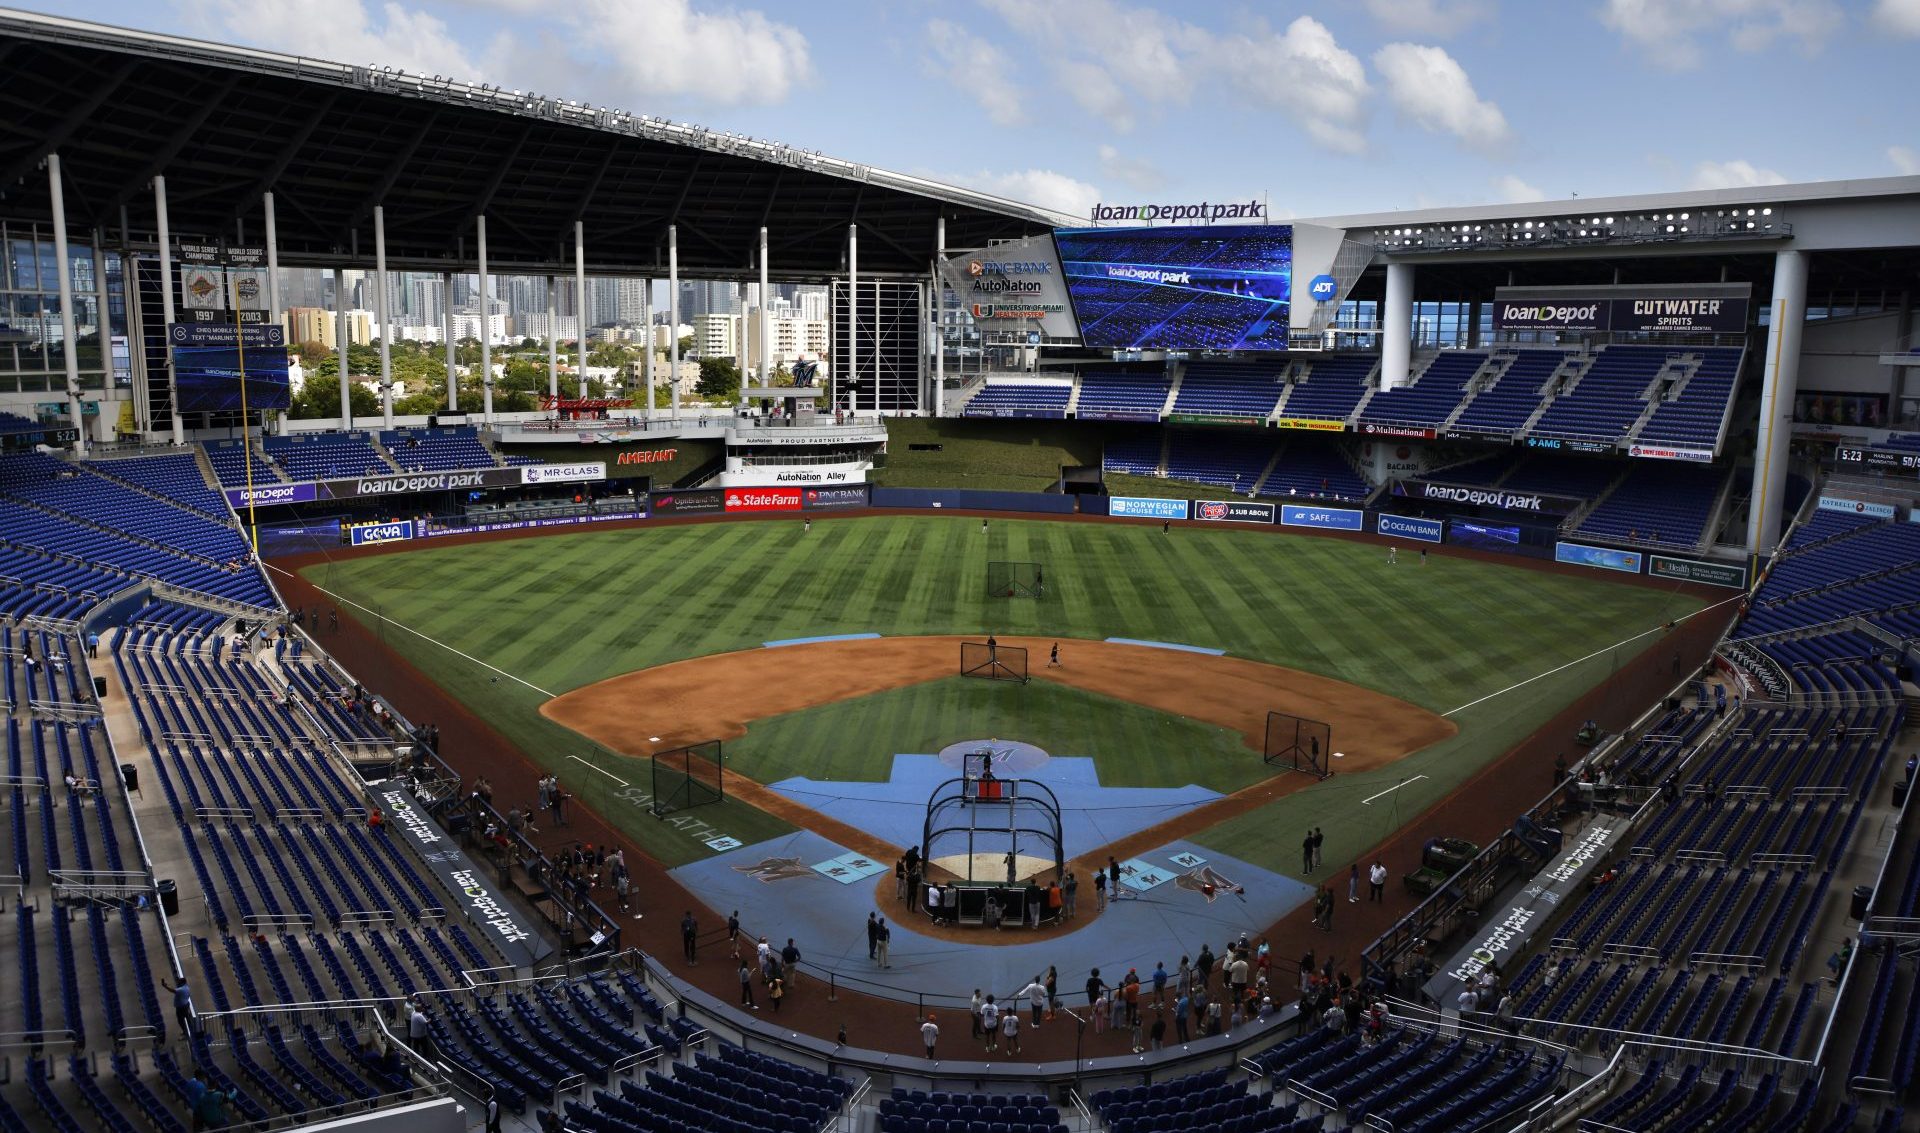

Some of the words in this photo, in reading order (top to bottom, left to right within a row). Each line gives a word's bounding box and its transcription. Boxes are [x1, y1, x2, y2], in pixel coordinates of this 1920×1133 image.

[1095, 202, 1207, 223] loanDepot
[1212, 200, 1262, 222] park
[201, 246, 218, 254] SERIES
[246, 248, 263, 256] SERIES
[185, 252, 215, 261] CHAMPIONS
[231, 254, 260, 262] CHAMPIONS
[984, 262, 1012, 274] PNC
[1014, 262, 1052, 274] BANK
[1108, 266, 1161, 281] loanDepot
[1160, 271, 1190, 284] park
[973, 279, 1041, 292] AutoNation
[1312, 282, 1334, 293] ADT
[994, 304, 1031, 312] UNIVERSITY
[1043, 304, 1065, 312] MIAMI
[1503, 303, 1598, 324] loanDepot
[194, 310, 214, 321] 1997
[240, 311, 261, 322] 2003
[1657, 317, 1692, 325] SPIRITS
[1308, 423, 1342, 431] INSURANCE
[1375, 425, 1425, 437] Multinational
[56, 430, 76, 442] 5:23
[1537, 440, 1561, 449] AMG
[617, 448, 676, 465] AMERANT
[1841, 449, 1863, 462] 5:23
[1873, 452, 1894, 460] MARLINS
[1867, 458, 1898, 466] FOUNDATION
[356, 473, 447, 495] loanDepot
[448, 471, 484, 489] park
[777, 473, 822, 482] AutoNation
[827, 472, 847, 481] Alley
[240, 486, 294, 500] loanDepot
[840, 489, 865, 498] BANK
[1424, 483, 1506, 505] loanDepot
[1505, 495, 1543, 510] park
[1126, 500, 1185, 511] NORWEGIAN
[1126, 507, 1153, 515] CRUISE
[1821, 499, 1856, 508] ESTRELLA
[1864, 505, 1892, 514] JALISCO
[1310, 513, 1330, 522] SAFE
[363, 525, 401, 541] GOYA
[1391, 522, 1416, 532] OCEAN
[1417, 526, 1440, 536] BANK
[382, 790, 428, 828] loanDepot
[406, 823, 442, 844] park
[1546, 841, 1594, 882] loanDepot
[1586, 827, 1613, 847] park
[450, 869, 510, 919] loanDepot
[485, 917, 531, 943] park
[1447, 926, 1516, 982] loanDepot
[1502, 906, 1536, 933] park
